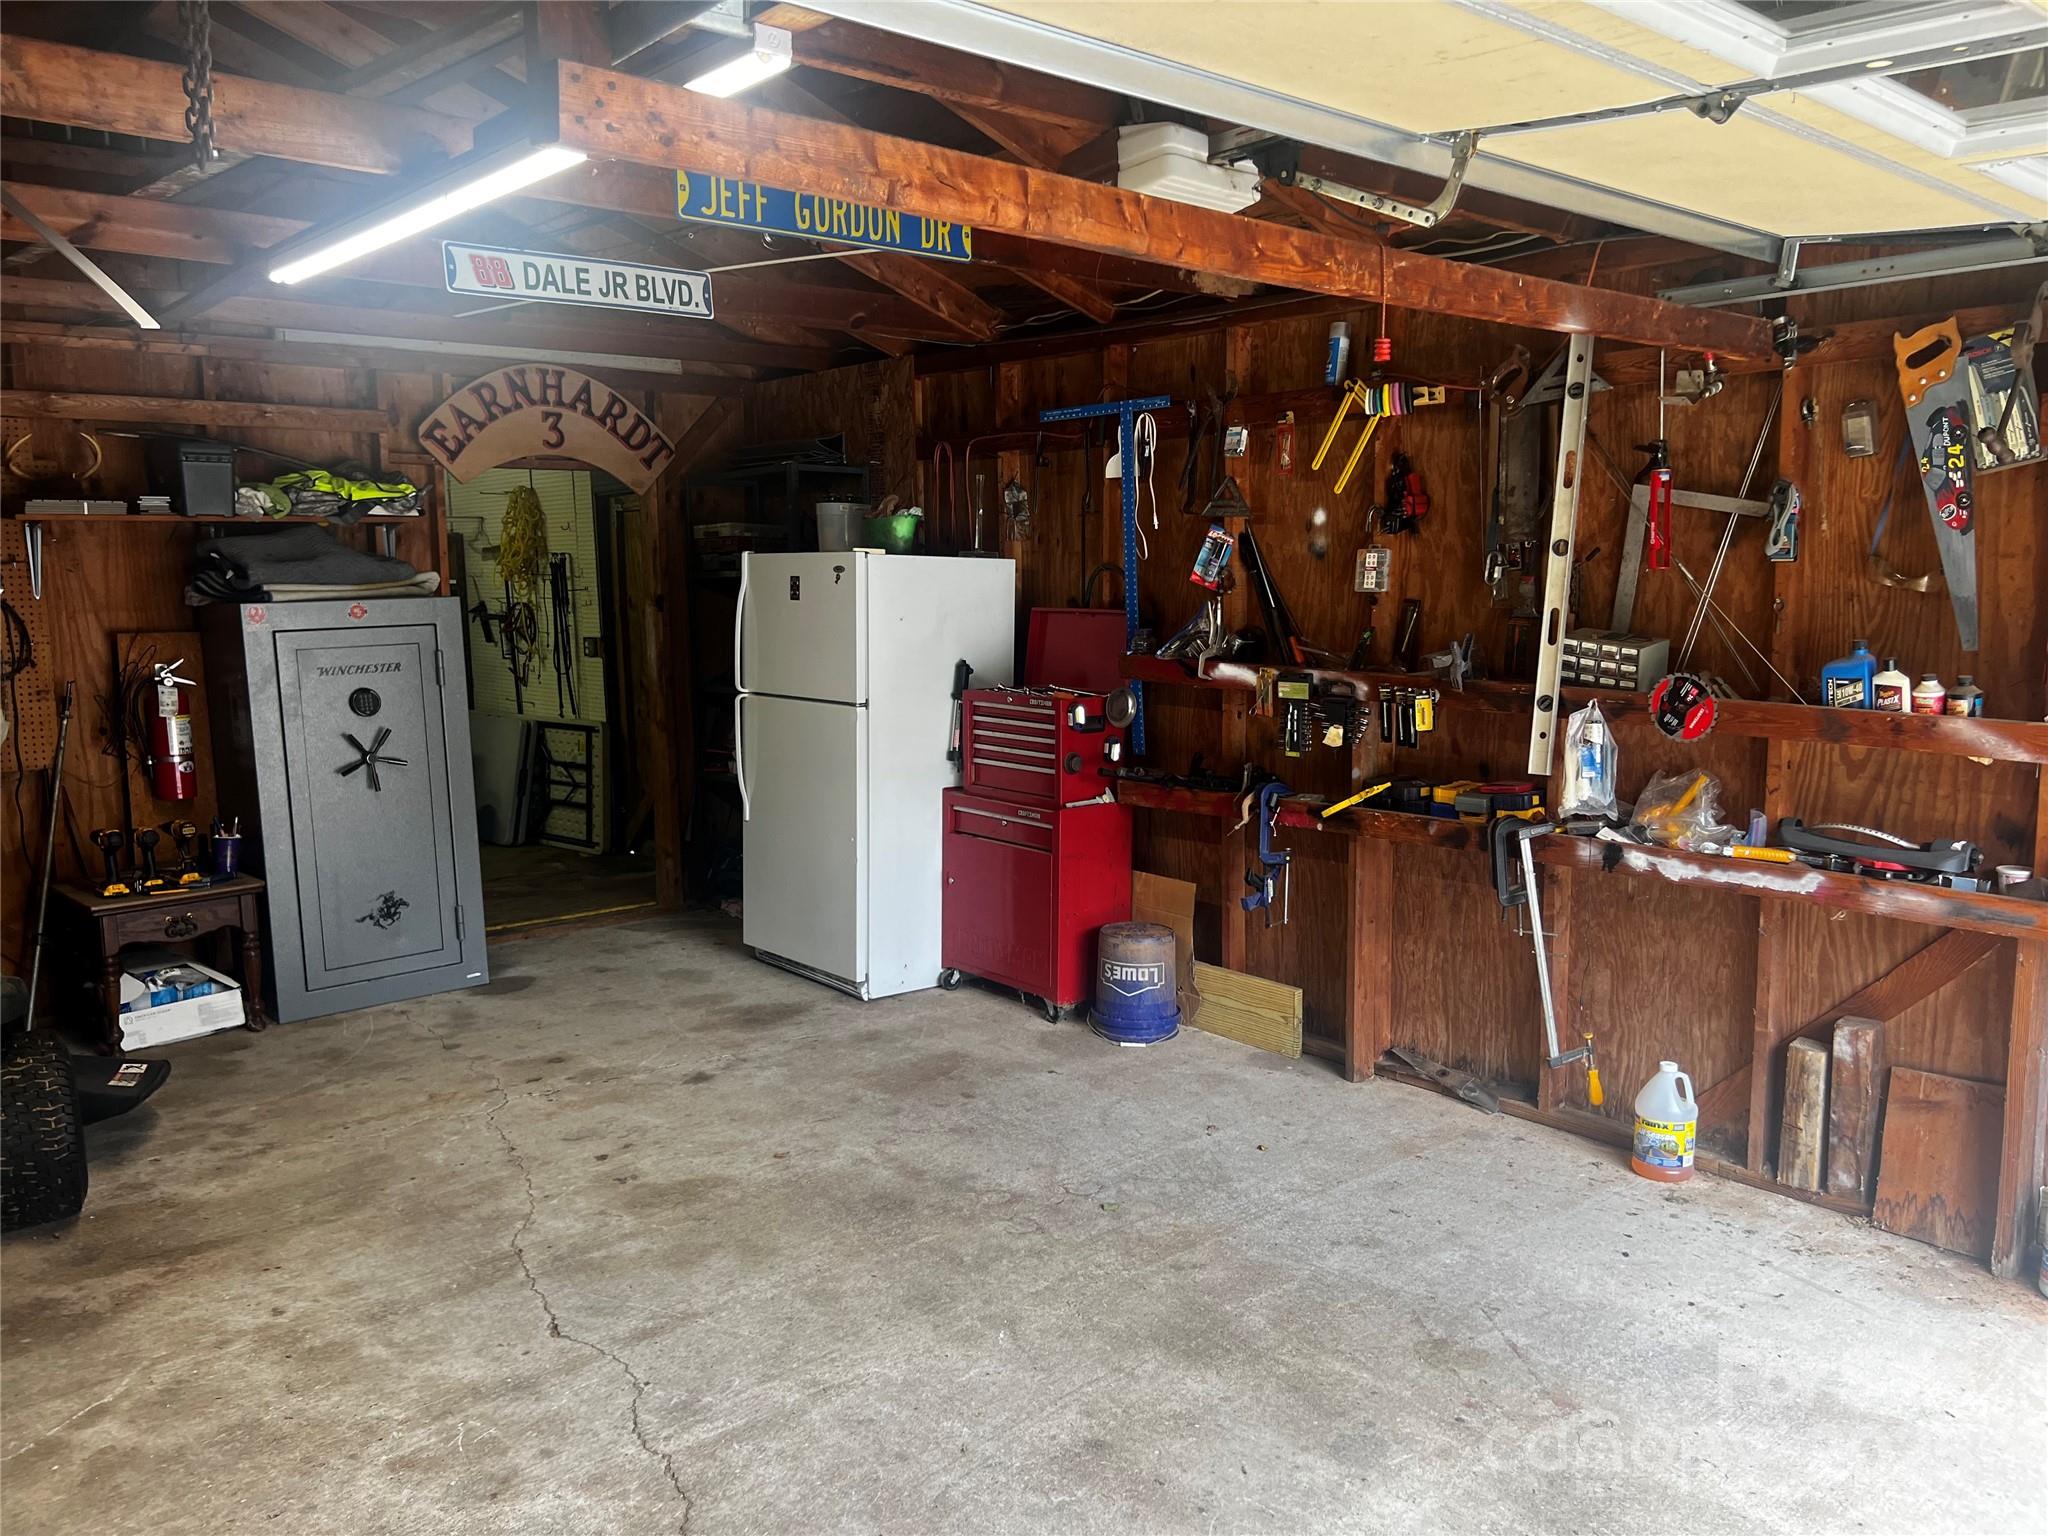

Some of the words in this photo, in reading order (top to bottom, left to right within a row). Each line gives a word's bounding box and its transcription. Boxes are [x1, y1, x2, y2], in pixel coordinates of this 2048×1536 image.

[701, 175, 768, 223] JEFF
[794, 190, 900, 244] GORDON
[920, 215, 952, 253] DR
[469, 254, 515, 290] 88
[523, 261, 592, 297] DALE
[599, 270, 630, 300] JR
[635, 274, 700, 309] BLVD.
[420, 367, 675, 471] EARNHARDT
[541, 410, 565, 450] 3
[1942, 416, 1952, 447] DUPONT
[1947, 443, 1965, 469] 24
[317, 663, 402, 677] WINCHESTER
[1104, 963, 1159, 984] LOWE'S
